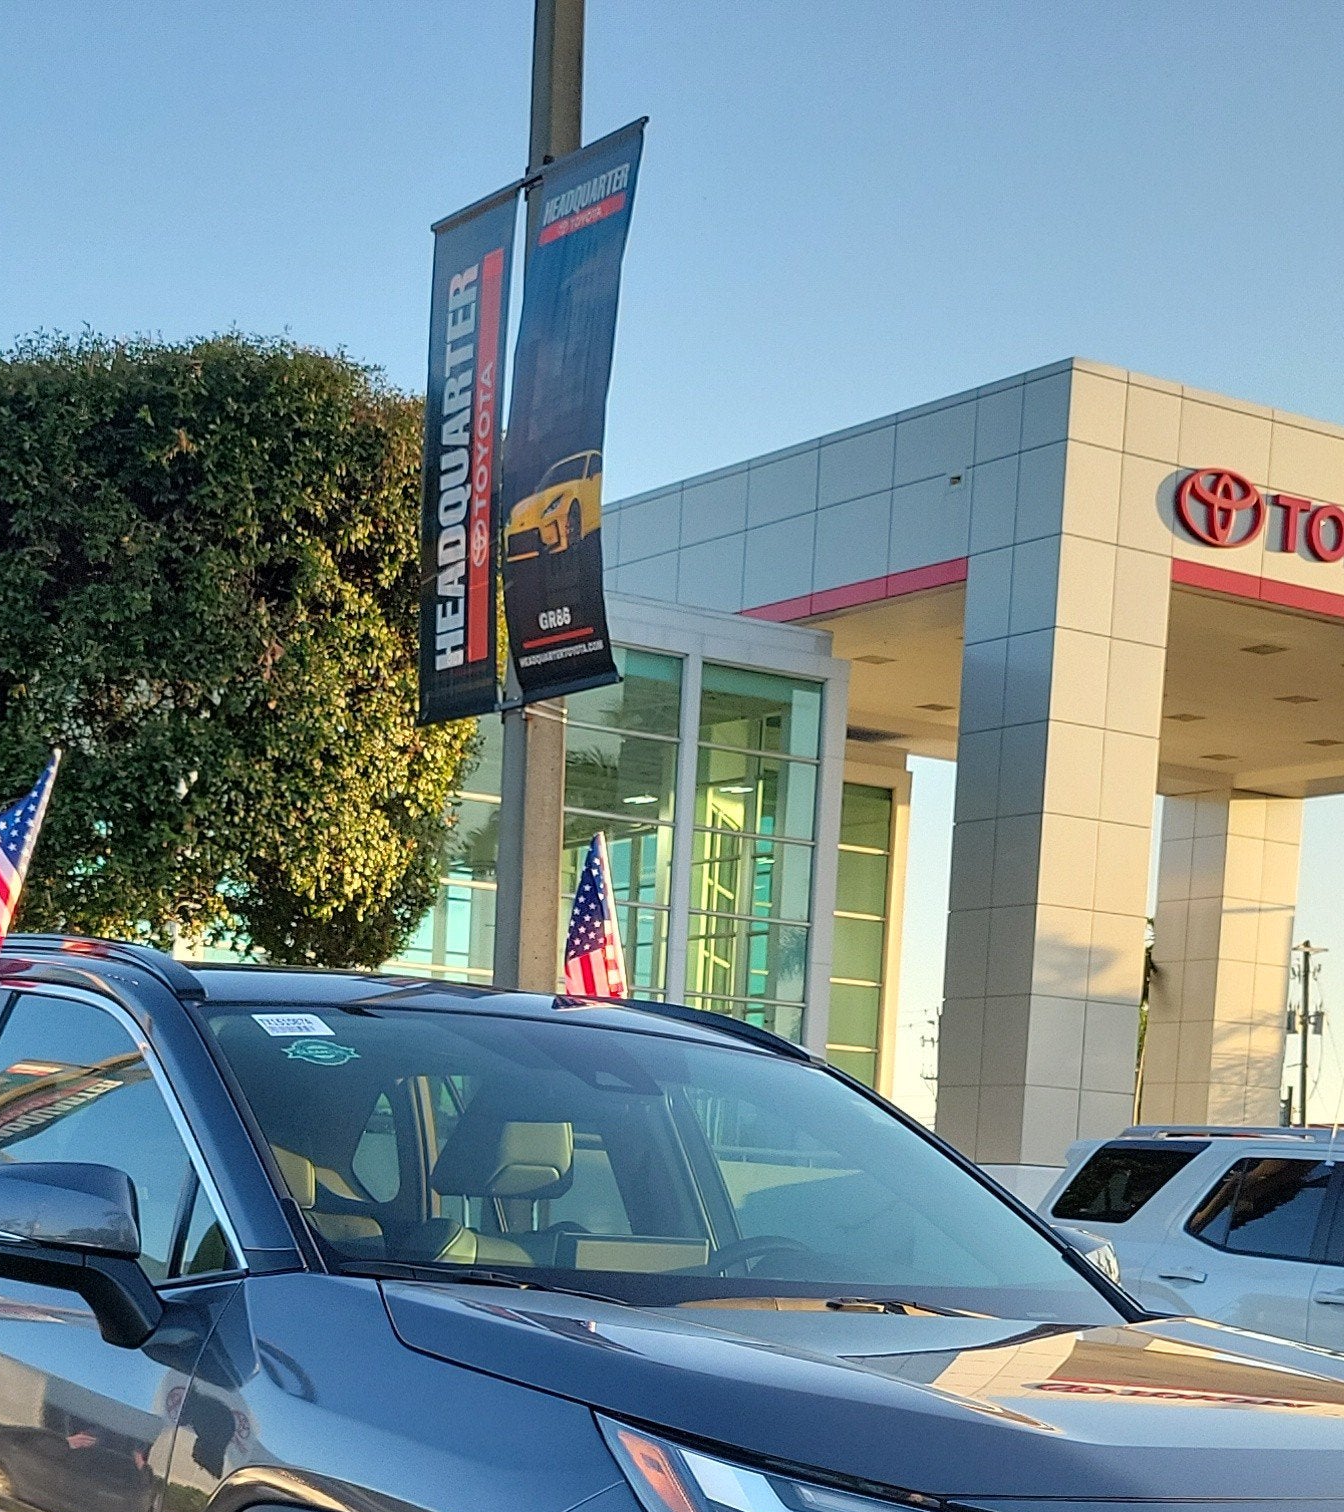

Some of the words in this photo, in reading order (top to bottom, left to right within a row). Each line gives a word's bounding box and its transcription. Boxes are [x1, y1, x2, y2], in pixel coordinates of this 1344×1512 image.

[543, 163, 631, 227] HEADQUARTER
[435, 263, 479, 671] HEADQUARTER
[474, 361, 493, 518] TOYOTA
[539, 606, 571, 630] GR86
